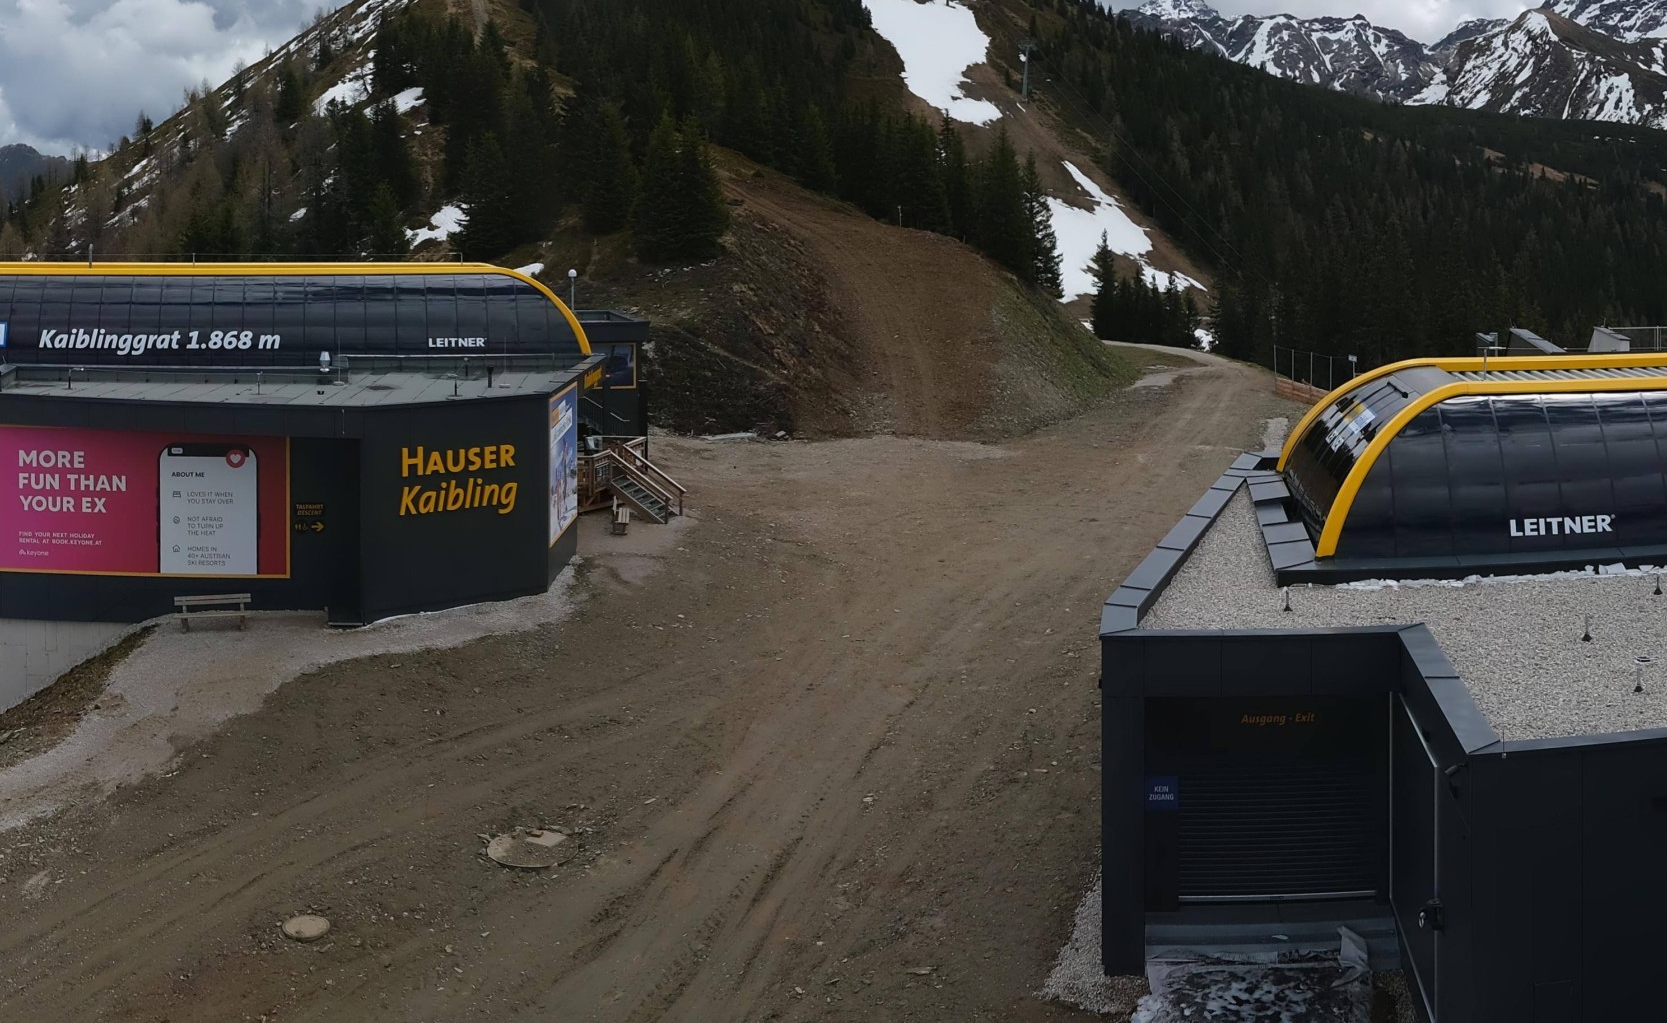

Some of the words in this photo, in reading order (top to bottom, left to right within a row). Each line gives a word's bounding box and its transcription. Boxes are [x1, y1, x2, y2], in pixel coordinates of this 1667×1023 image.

[39, 328, 181, 355] Kaiblinggrat
[186, 330, 253, 350] 1.868
[258, 334, 281, 350] m
[18, 449, 85, 468] MORE
[401, 444, 516, 478] HAUSER
[18, 473, 59, 490] FUN
[67, 474, 126, 491] THAN
[20, 495, 75, 512] YOUR
[82, 497, 107, 513] EX
[400, 478, 518, 516] Kaibling
[1241, 714, 1286, 726] Ausgang
[1295, 712, 1315, 722] Exit
[1149, 793, 1174, 801] ZUGANG
[1154, 785, 1169, 793] KEIN
